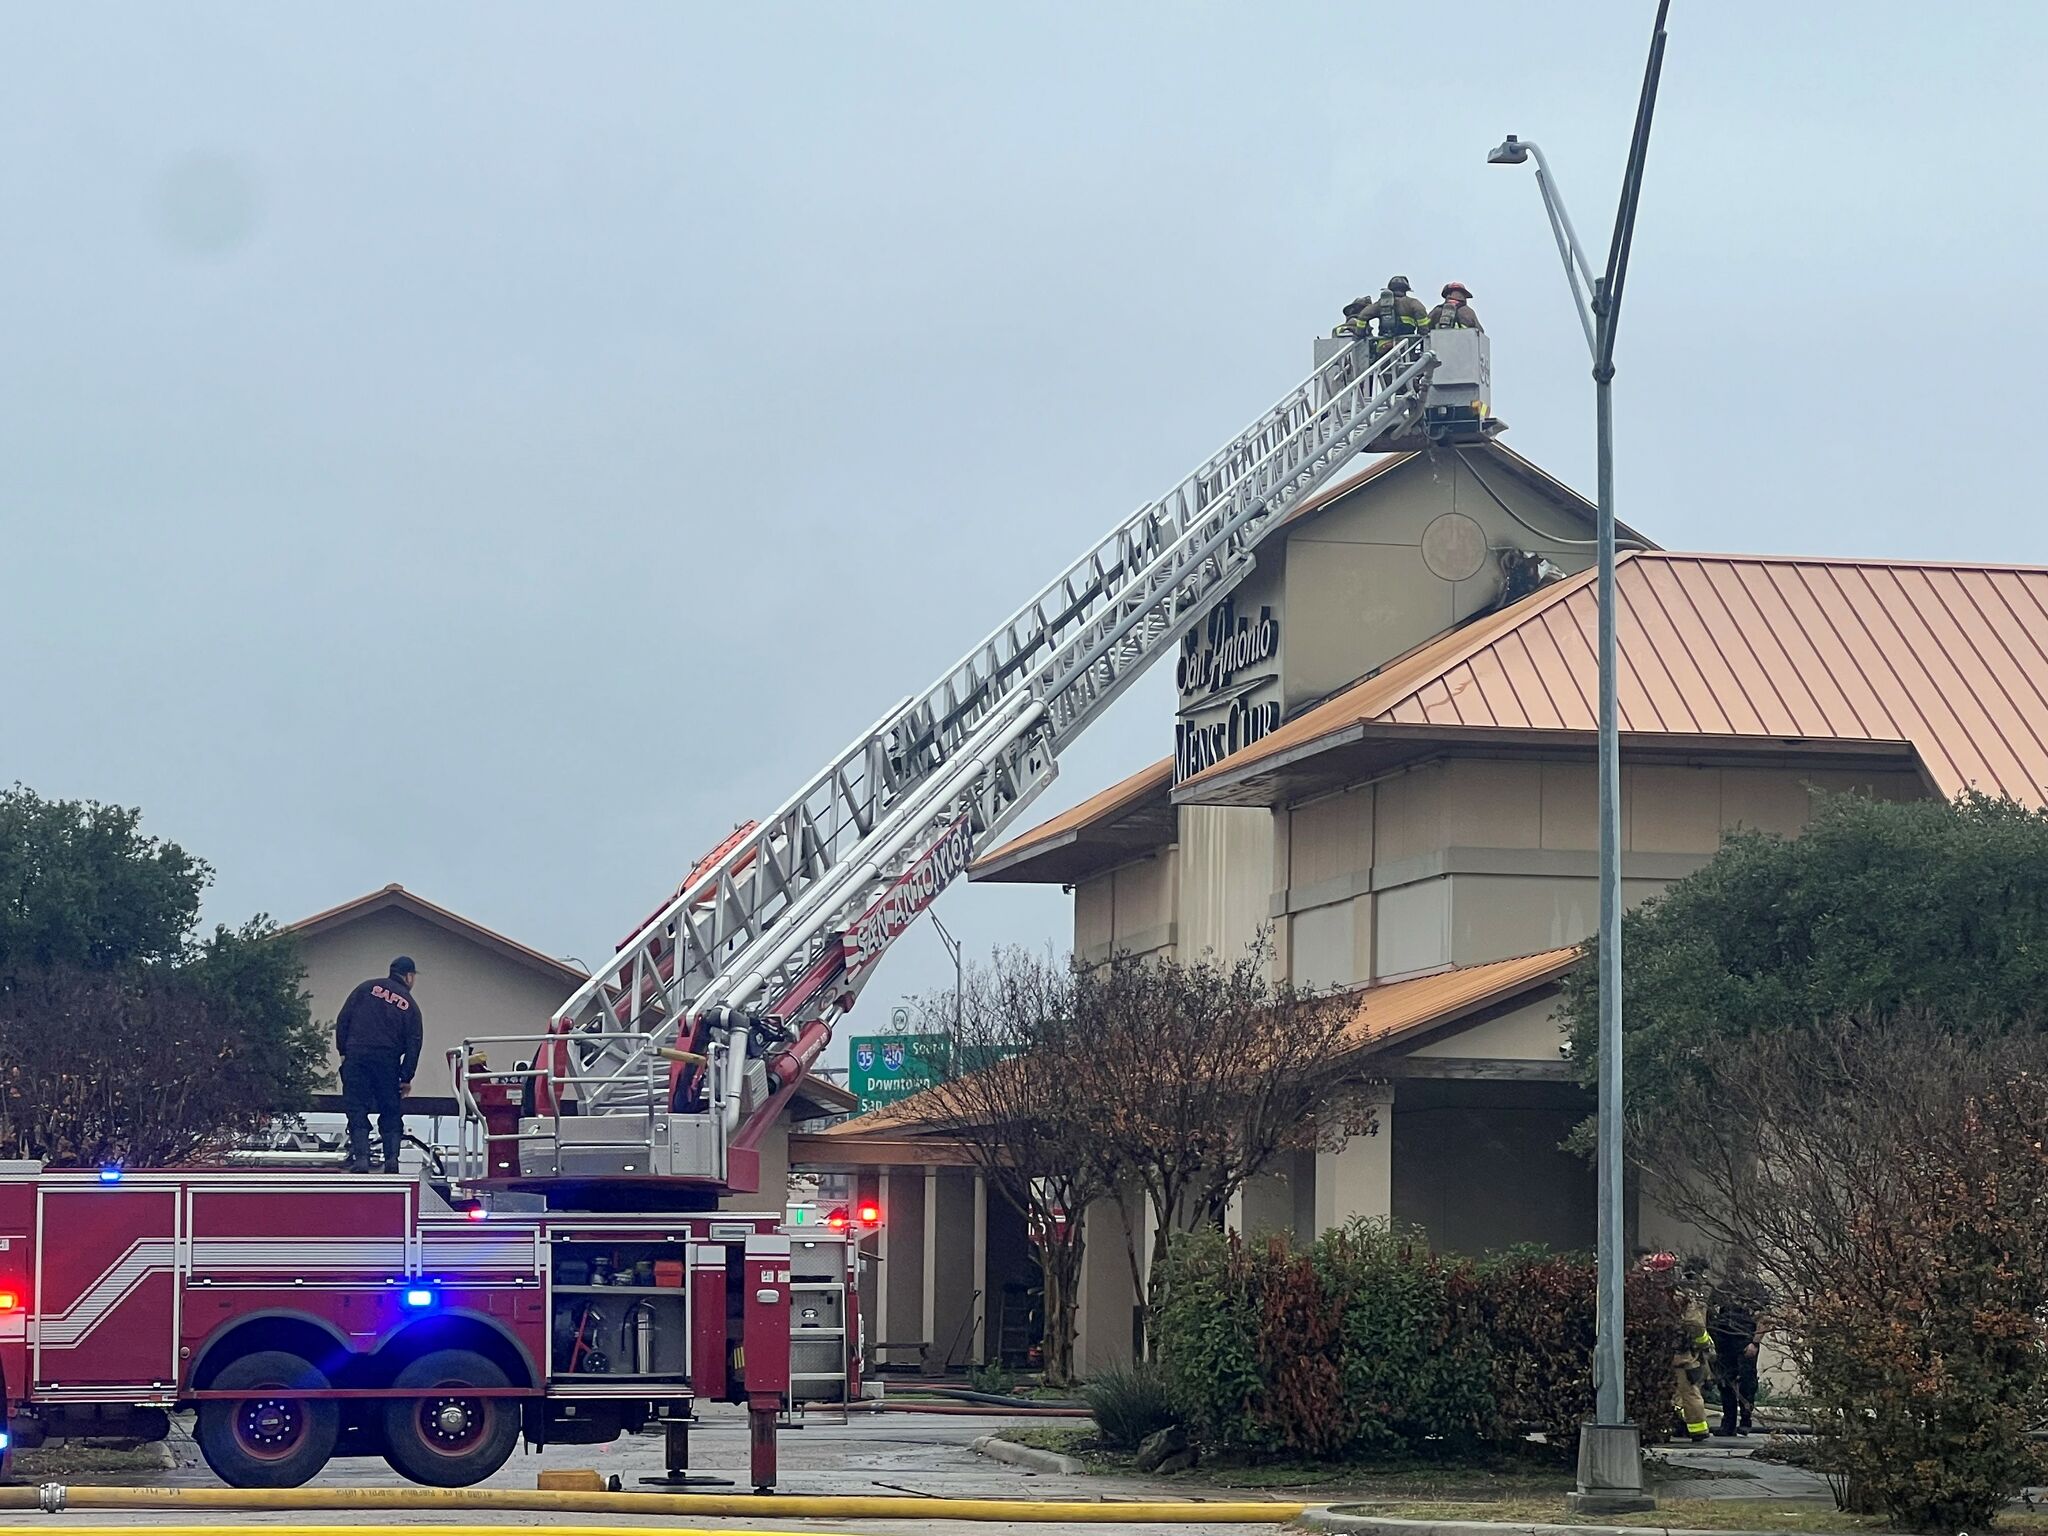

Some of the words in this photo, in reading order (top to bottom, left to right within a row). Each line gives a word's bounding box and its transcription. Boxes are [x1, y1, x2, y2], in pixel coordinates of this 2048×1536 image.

[1207, 599, 1278, 692] Antonio
[857, 904, 890, 962] SAN
[894, 831, 964, 928] ANTONIO
[371, 985, 410, 1011] SAFD
[860, 1051, 873, 1067] 35
[885, 1051, 902, 1065] 410
[867, 1077, 930, 1091] Downtown
[861, 1098, 883, 1112] San
